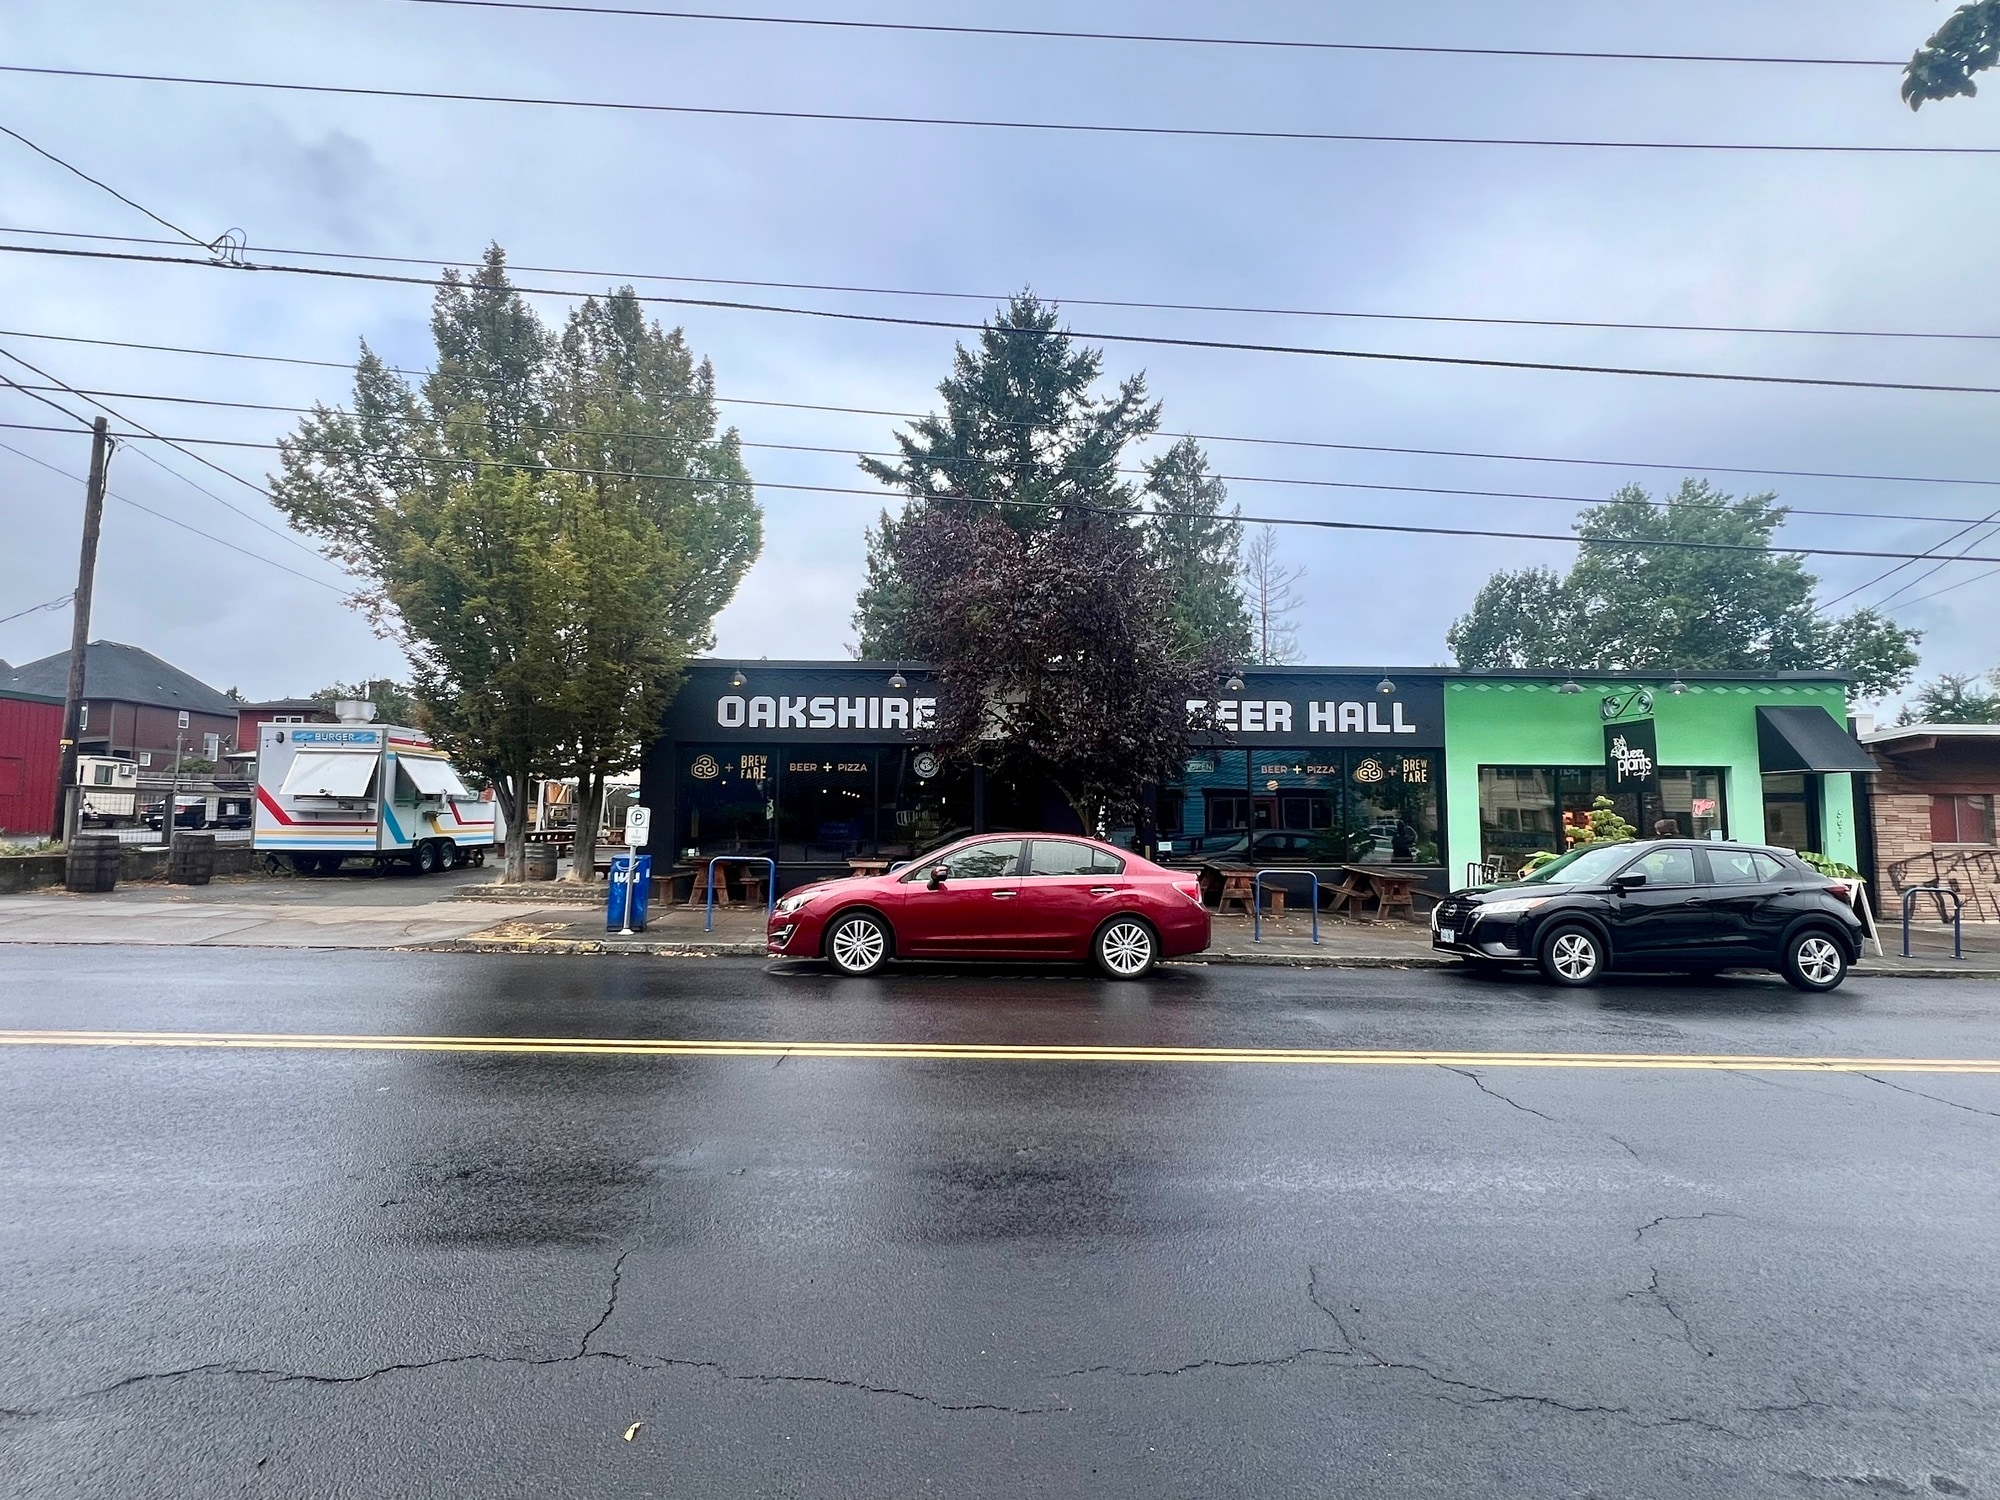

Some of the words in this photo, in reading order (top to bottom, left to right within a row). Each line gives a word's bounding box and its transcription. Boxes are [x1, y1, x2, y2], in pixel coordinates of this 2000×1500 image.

[717, 695, 937, 729] OAKSHIRE
[1185, 700, 1292, 732] BEER
[1309, 701, 1416, 733] HALL
[315, 732, 355, 741] BURGER
[740, 755, 768, 769] BREW
[789, 762, 818, 772] BEER
[837, 763, 868, 772] PIZZA
[1403, 759, 1427, 771] BREW
[740, 765, 767, 779] FARE
[1261, 765, 1288, 774] BEER
[1306, 765, 1336, 774] PIZZA
[1618, 756, 1652, 783] plants
[1403, 771, 1427, 783] FARE
[634, 812, 643, 822] P
